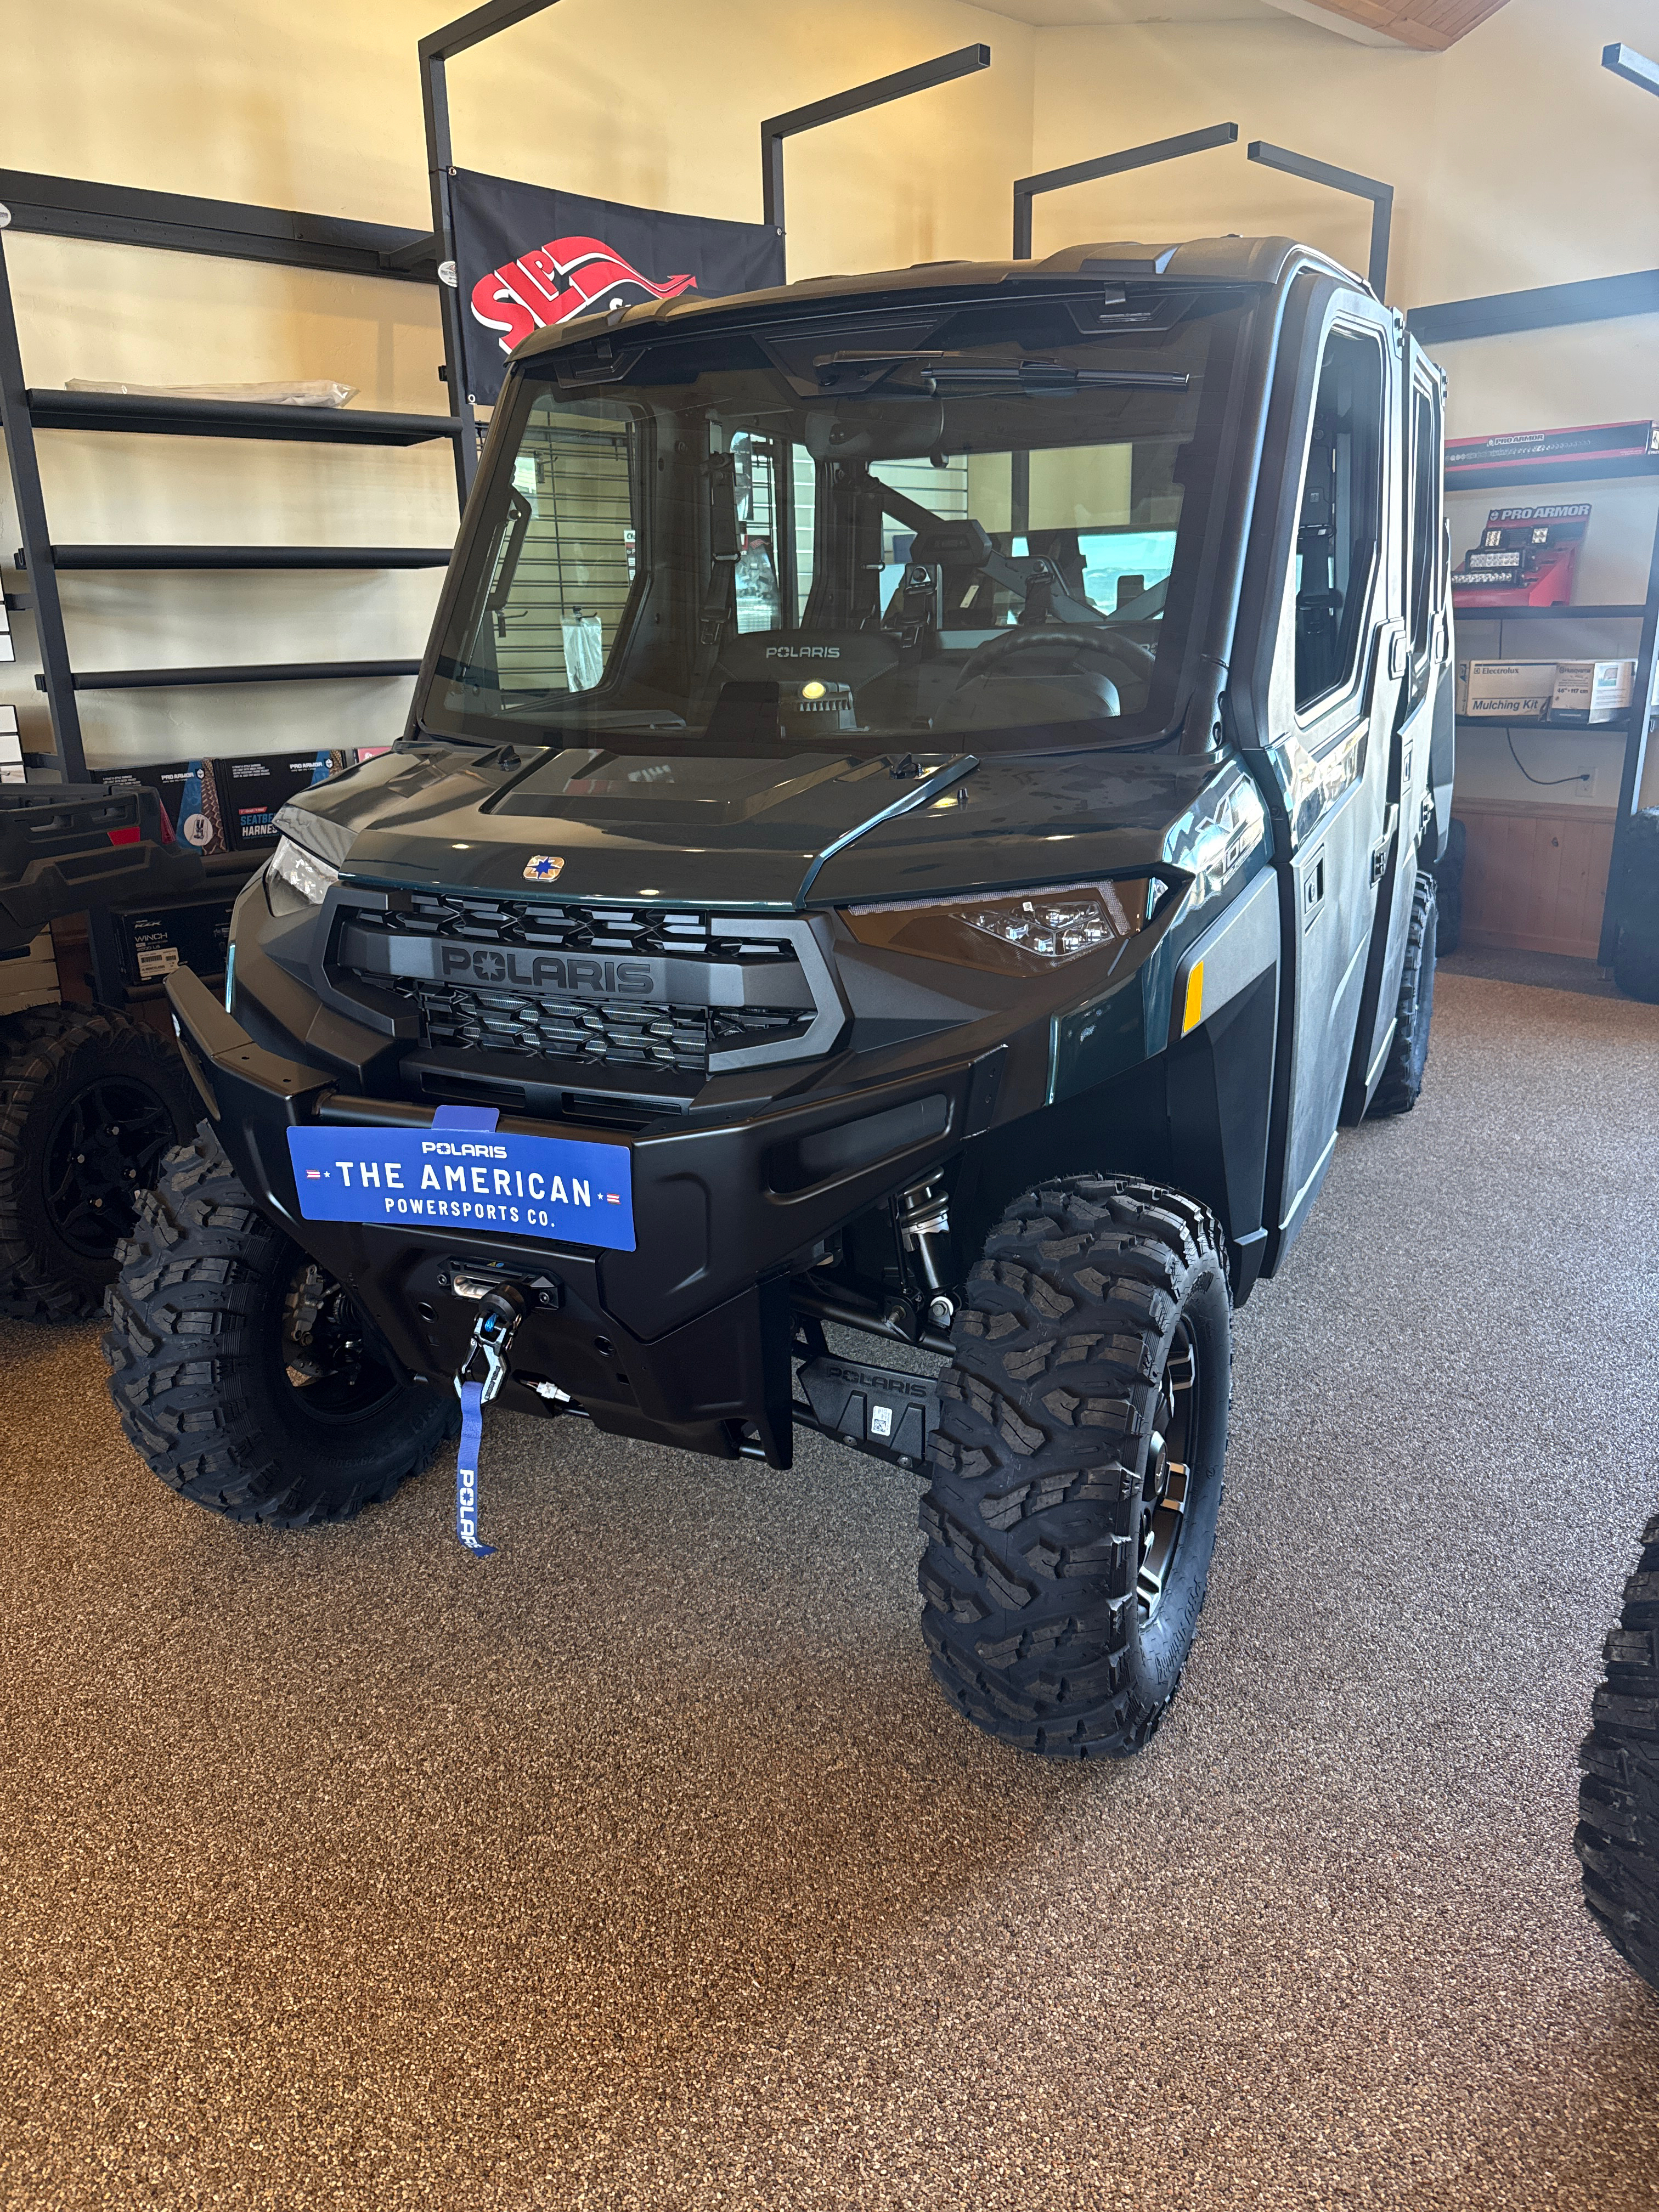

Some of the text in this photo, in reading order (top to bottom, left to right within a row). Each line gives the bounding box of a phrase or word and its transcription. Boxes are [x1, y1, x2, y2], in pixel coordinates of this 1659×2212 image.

[1513, 434, 1544, 443] ARMOR
[1502, 505, 1590, 521] PRO ARMOR
[765, 645, 840, 659] POLARIS
[1472, 699, 1538, 711] Mulching Kit
[240, 813, 275, 826] SEATBE
[242, 824, 278, 837] HARNES
[134, 932, 168, 943] WINCH
[441, 946, 654, 995] POLARIS
[422, 1142, 507, 1159] POLARIS
[335, 1161, 591, 1207] THE AMERICAN
[385, 1198, 555, 1228] POWERSPORTS CO.
[827, 1367, 927, 1397] POLARIS
